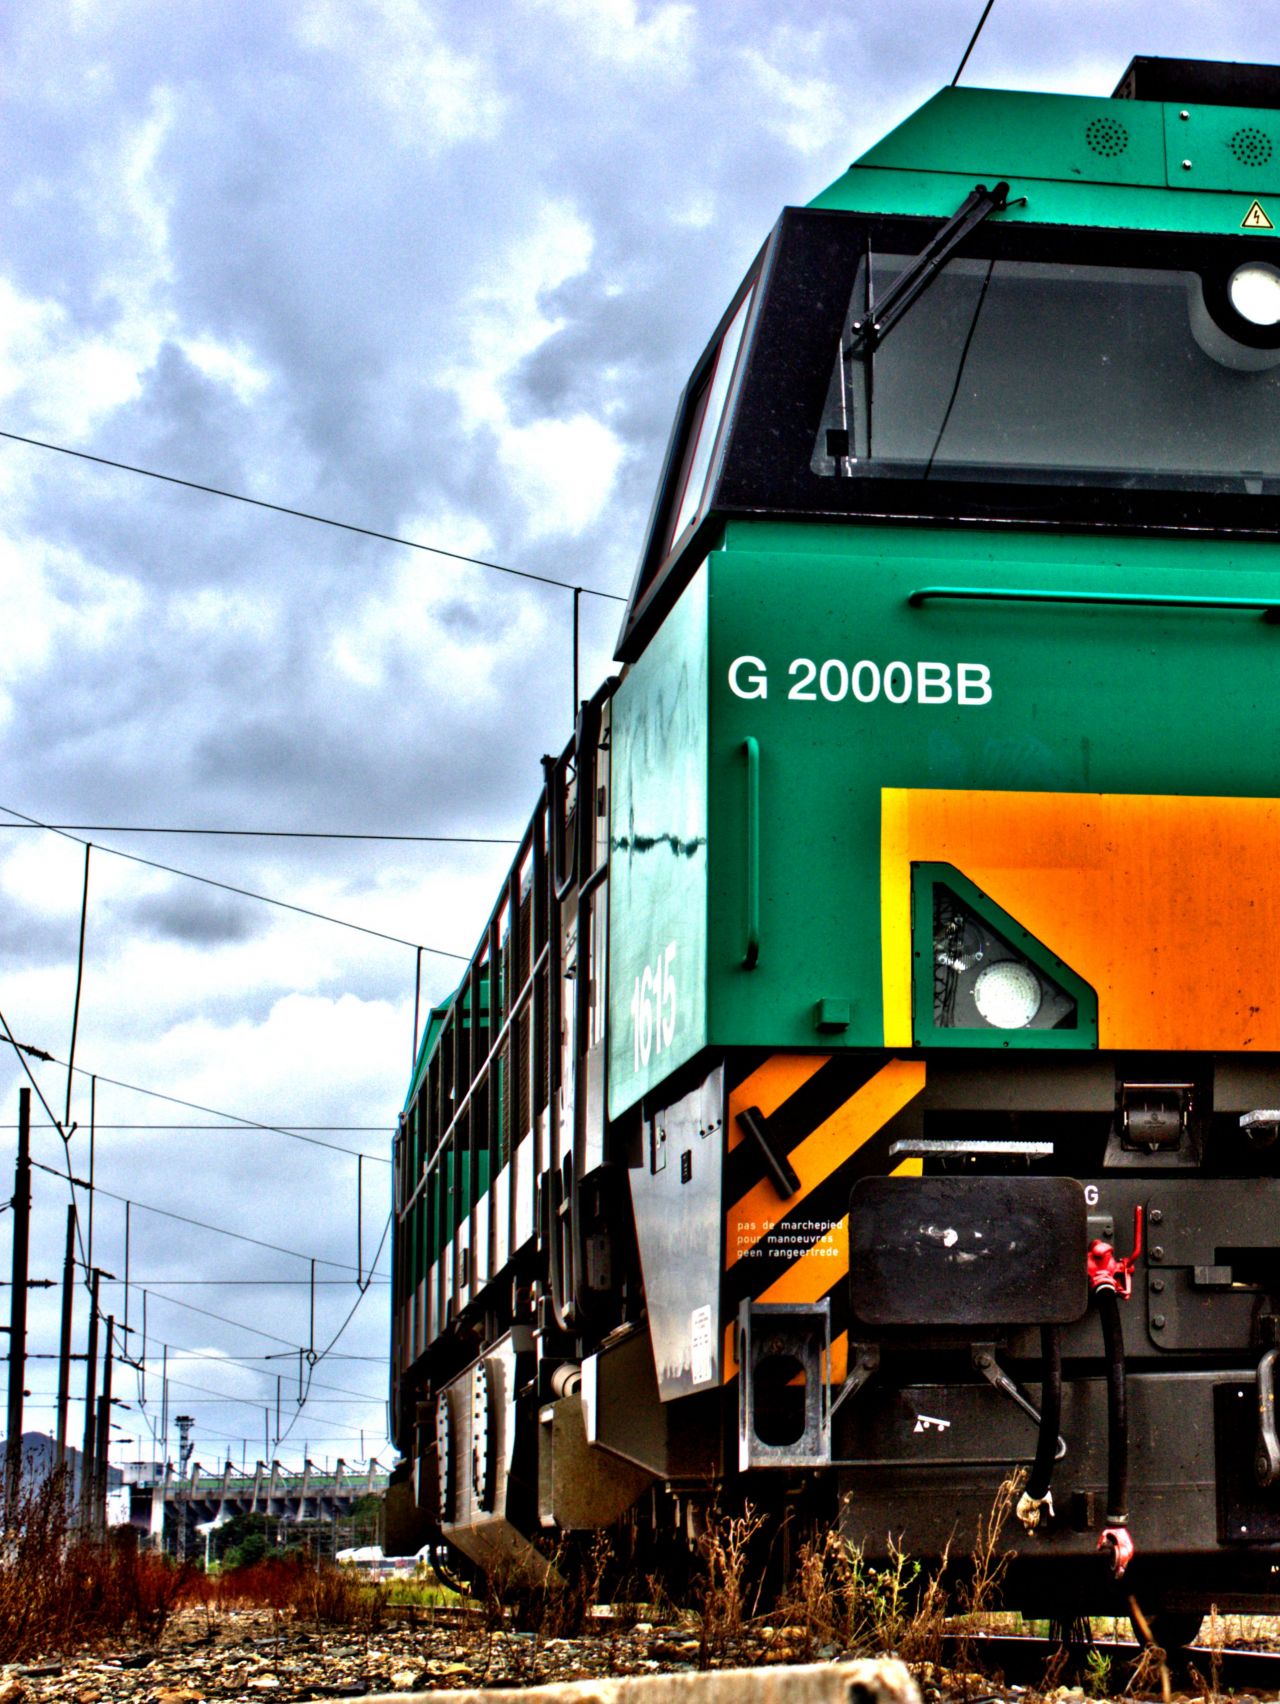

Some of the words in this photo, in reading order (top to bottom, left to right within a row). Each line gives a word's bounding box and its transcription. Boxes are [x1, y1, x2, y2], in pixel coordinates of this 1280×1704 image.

[728, 656, 768, 700] G
[788, 657, 993, 706] 2000BB
[630, 940, 676, 1073] 1615
[737, 1222, 756, 1232] pas
[762, 1220, 775, 1230] de
[781, 1220, 843, 1232] marchepied
[737, 1235, 761, 1244] pour
[767, 1235, 833, 1244] manoeuvres
[737, 1249, 763, 1260] geen
[768, 1247, 839, 1260] rangeertrede
